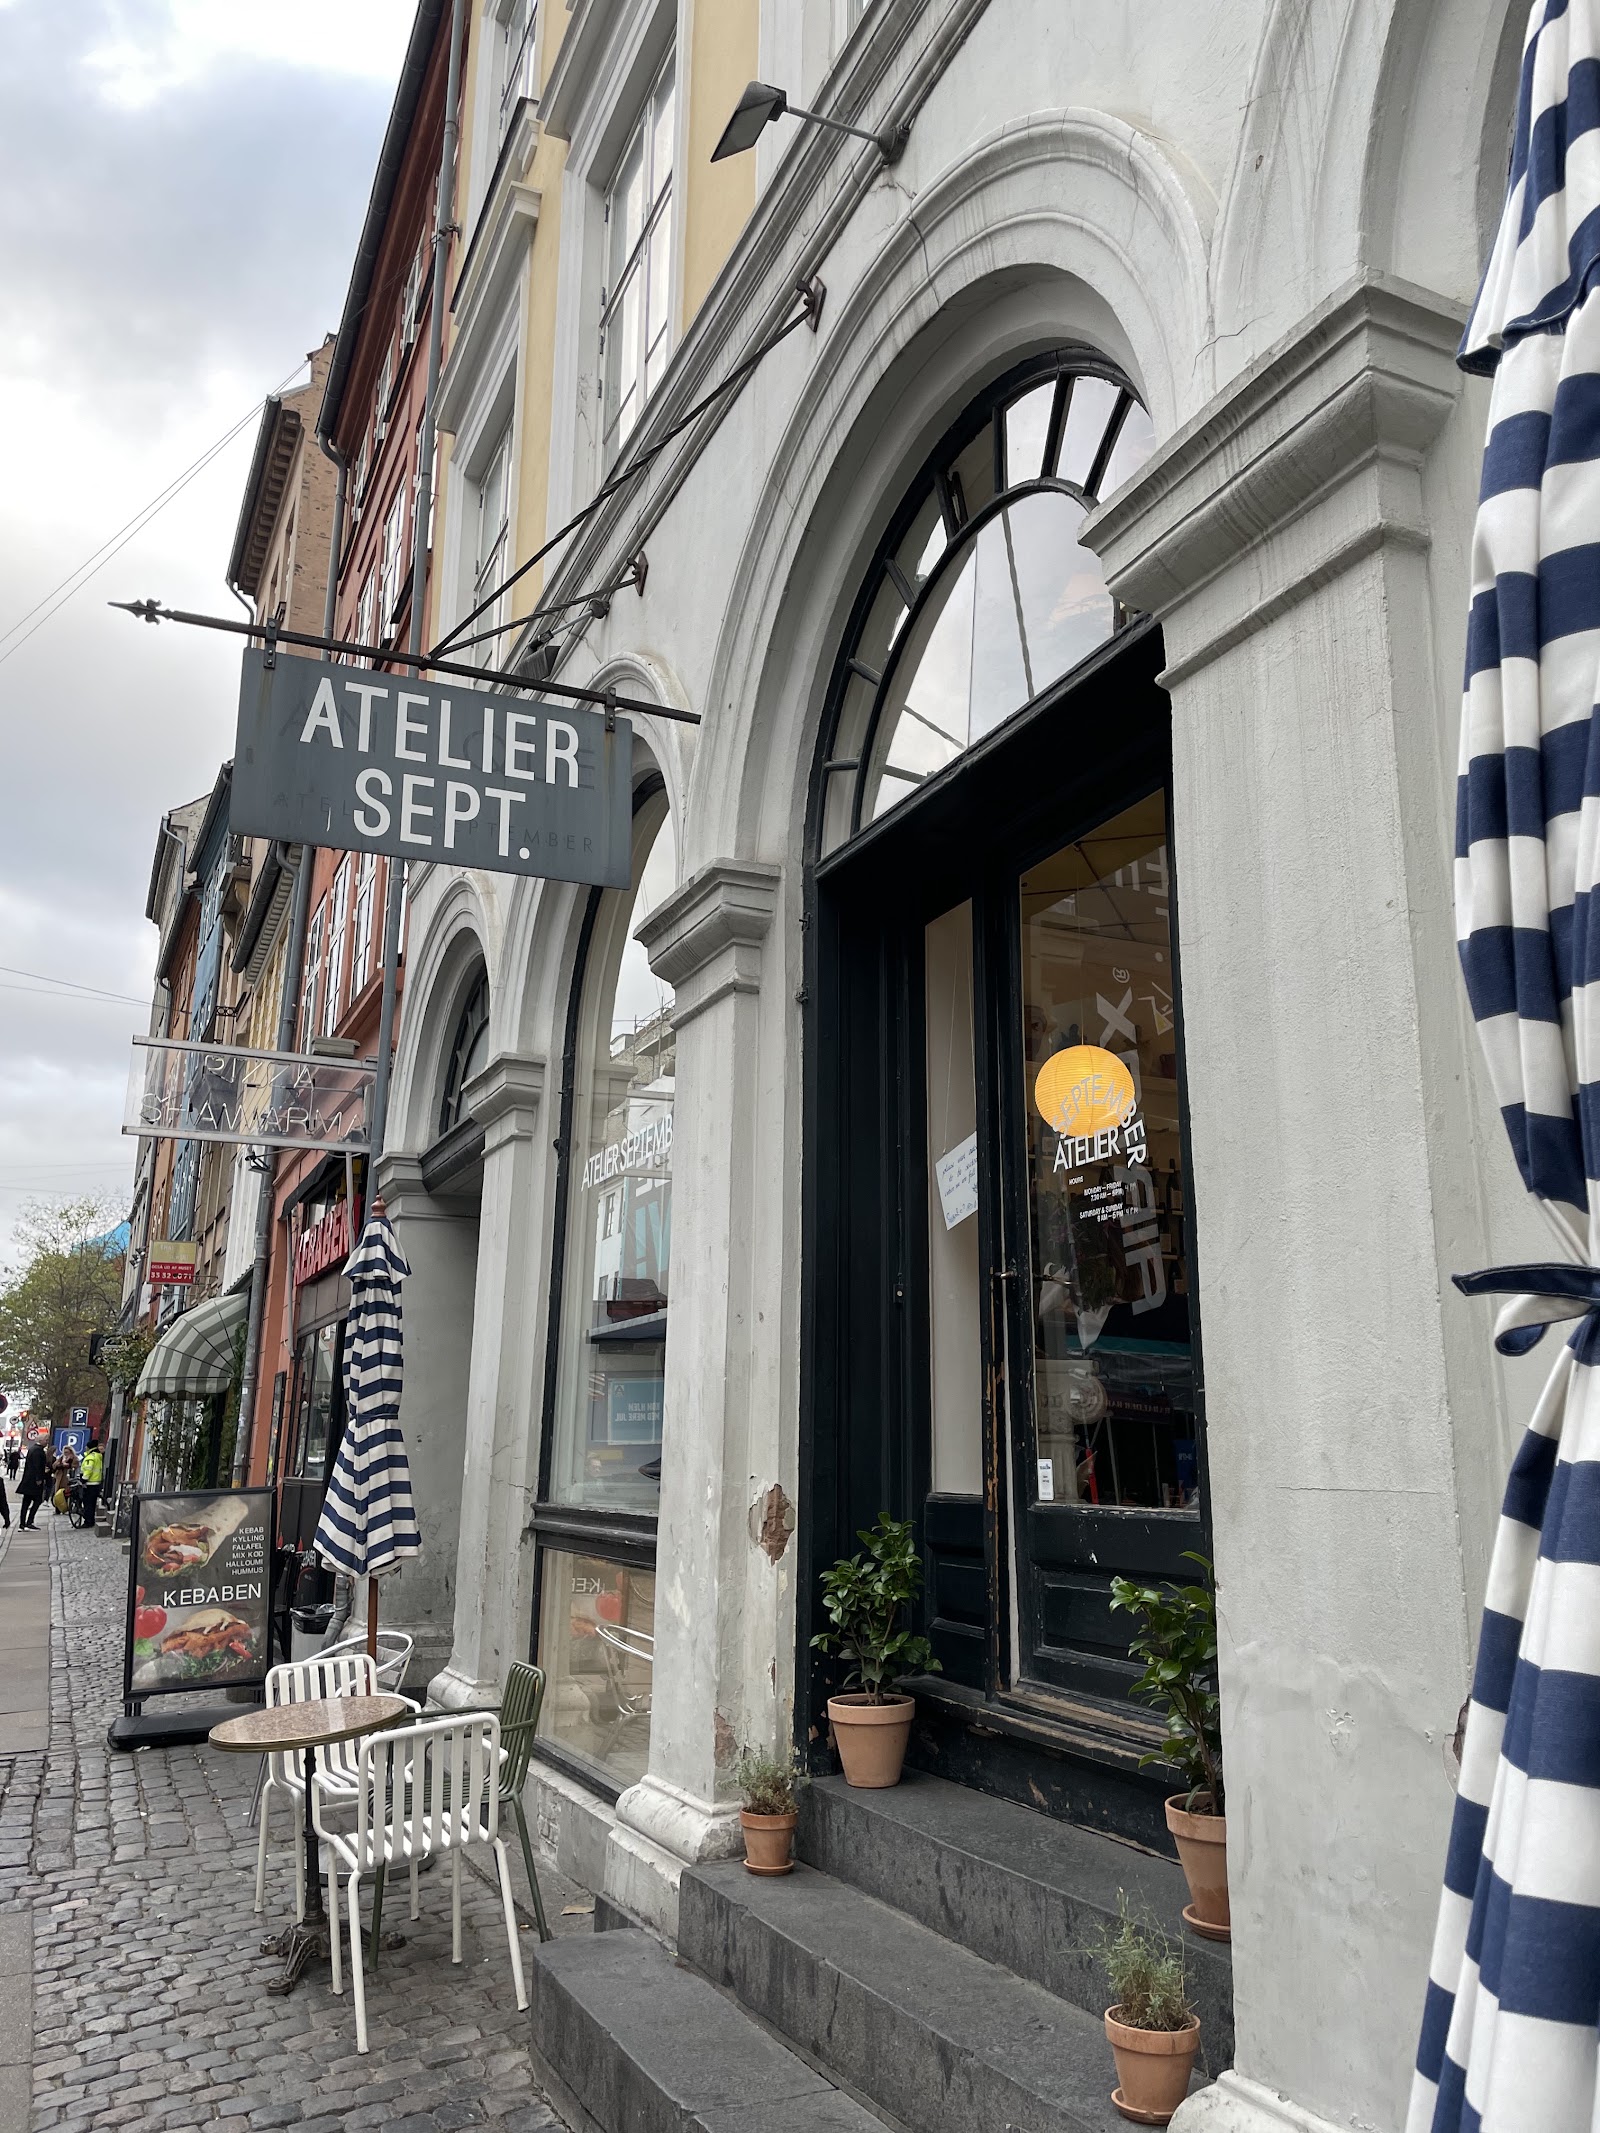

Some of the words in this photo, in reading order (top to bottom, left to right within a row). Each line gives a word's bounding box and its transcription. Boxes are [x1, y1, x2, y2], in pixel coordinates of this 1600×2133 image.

[300, 677, 579, 787] ATELIER
[353, 768, 530, 859] SEPT.
[204, 1055, 313, 1089] PIZZA
[140, 1093, 367, 1141] SHAWARMA
[1052, 1074, 1147, 1168] SEPTEMBER
[581, 1143, 619, 1191] ATELIER
[620, 1113, 673, 1171] SEPTEMB
[1053, 1125, 1121, 1173] ATELIER
[1084, 1186, 1102, 1196] MONDAY
[1106, 1181, 1122, 1190] FRIDAY
[1079, 1208, 1101, 1219] SATURDAY
[1105, 1202, 1123, 1213] SUNDAY
[294, 1197, 349, 1285] KEBABEN
[232, 1534, 265, 1543] KYLLING
[239, 1526, 264, 1534] KEBAB
[232, 1543, 264, 1551] FALAFEL
[225, 1559, 264, 1568] HALLOUMI
[231, 1567, 264, 1576] HUMMUS
[163, 1582, 262, 1607] KEBABEN
